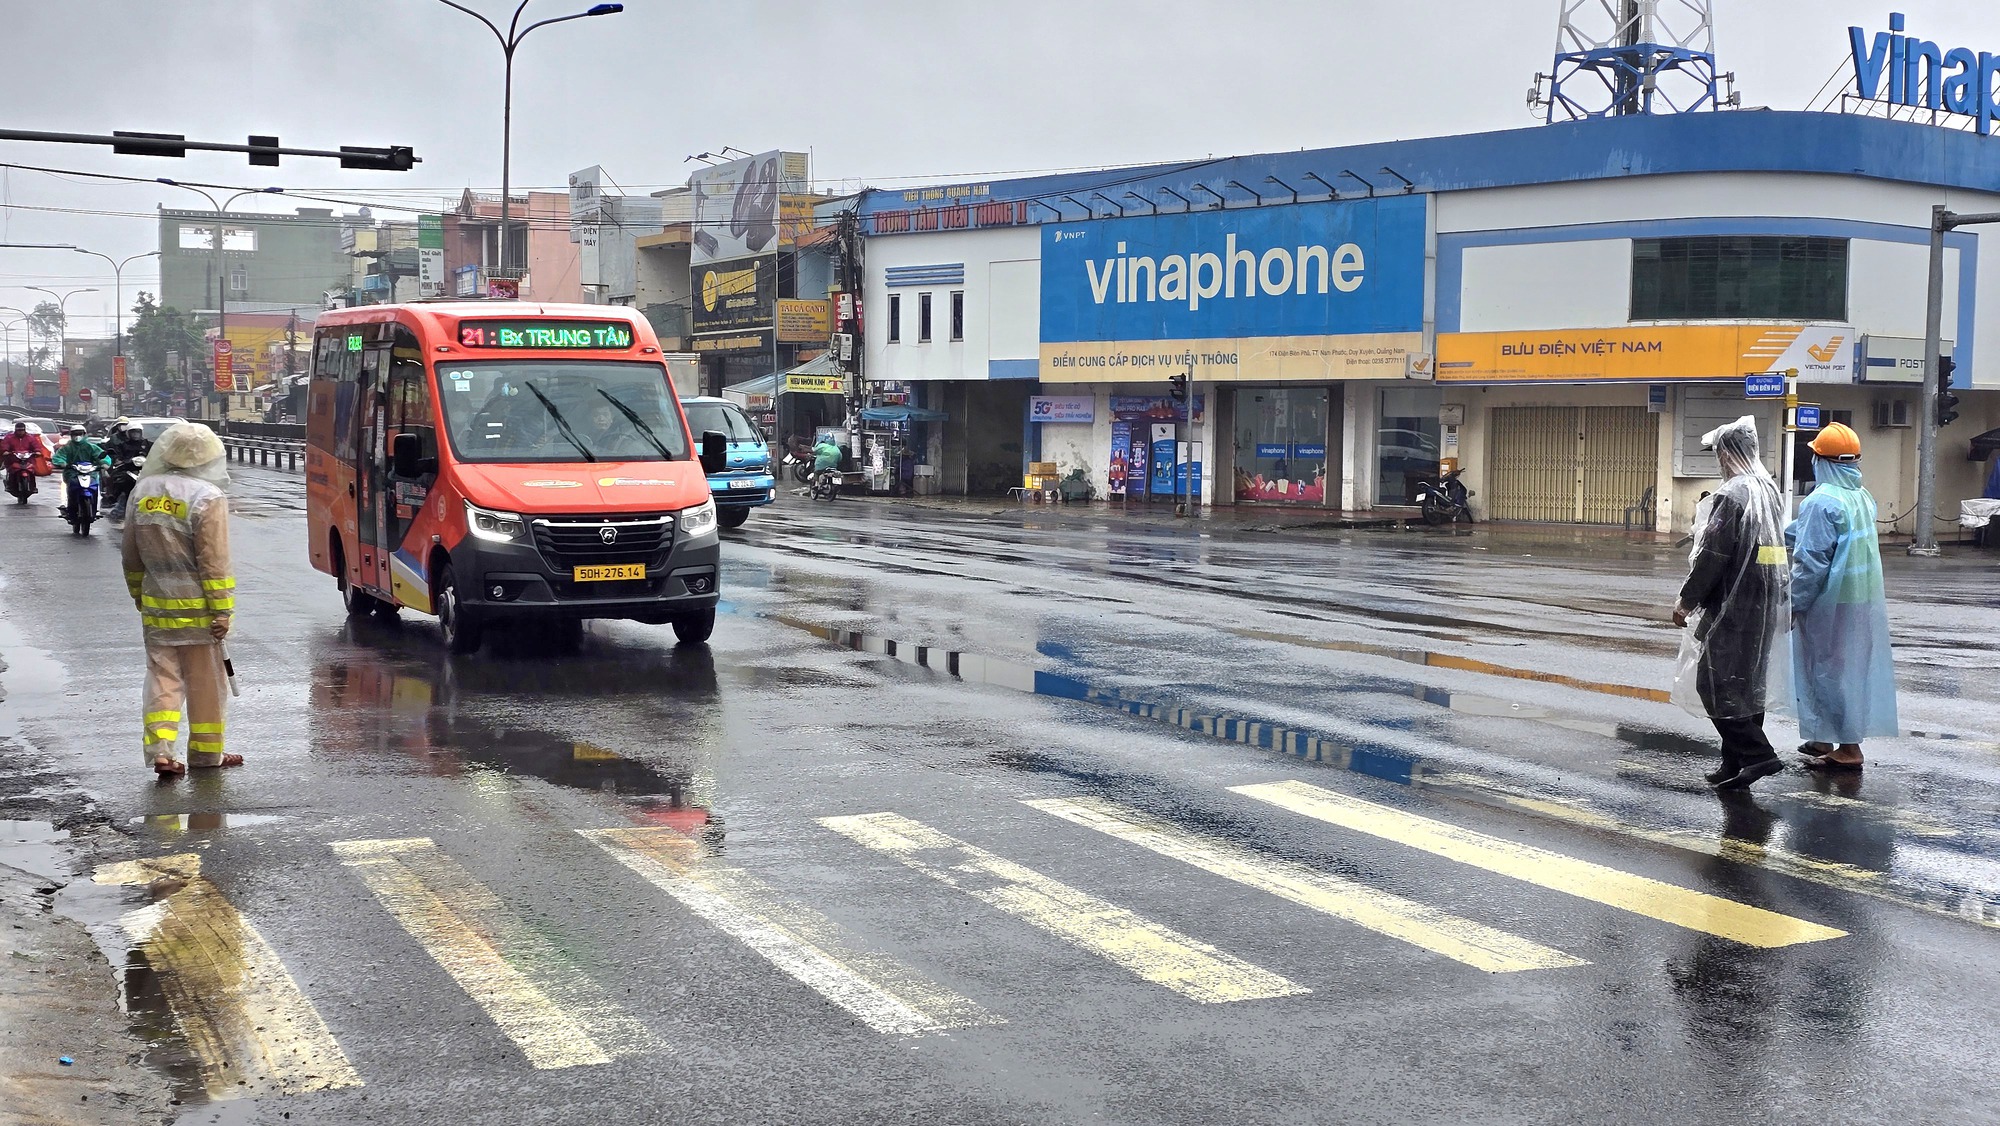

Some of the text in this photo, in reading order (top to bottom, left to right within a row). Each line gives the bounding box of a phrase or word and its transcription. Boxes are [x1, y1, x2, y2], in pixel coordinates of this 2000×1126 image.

[973, 184, 990, 196] NAM
[873, 209, 910, 234] TRUNG
[914, 204, 939, 231] TÂM
[942, 198, 969, 229] VIỄN
[973, 197, 1013, 228] THÔNG
[1063, 231, 1086, 240] VNPT
[1085, 233, 1365, 311] vinaphone
[462, 327, 485, 346] 21
[500, 328, 524, 346] Bx
[526, 328, 591, 347] TRUNG
[1502, 338, 1663, 357] BƯU ĐIỆN VIỆT NAM
[1052, 349, 1238, 369] ĐIỂM CUNG CẤP DỊCH VỤ VIỄN THÔNG
[145, 498, 181, 515] CGT
[580, 566, 640, 579] 50H-276.14
